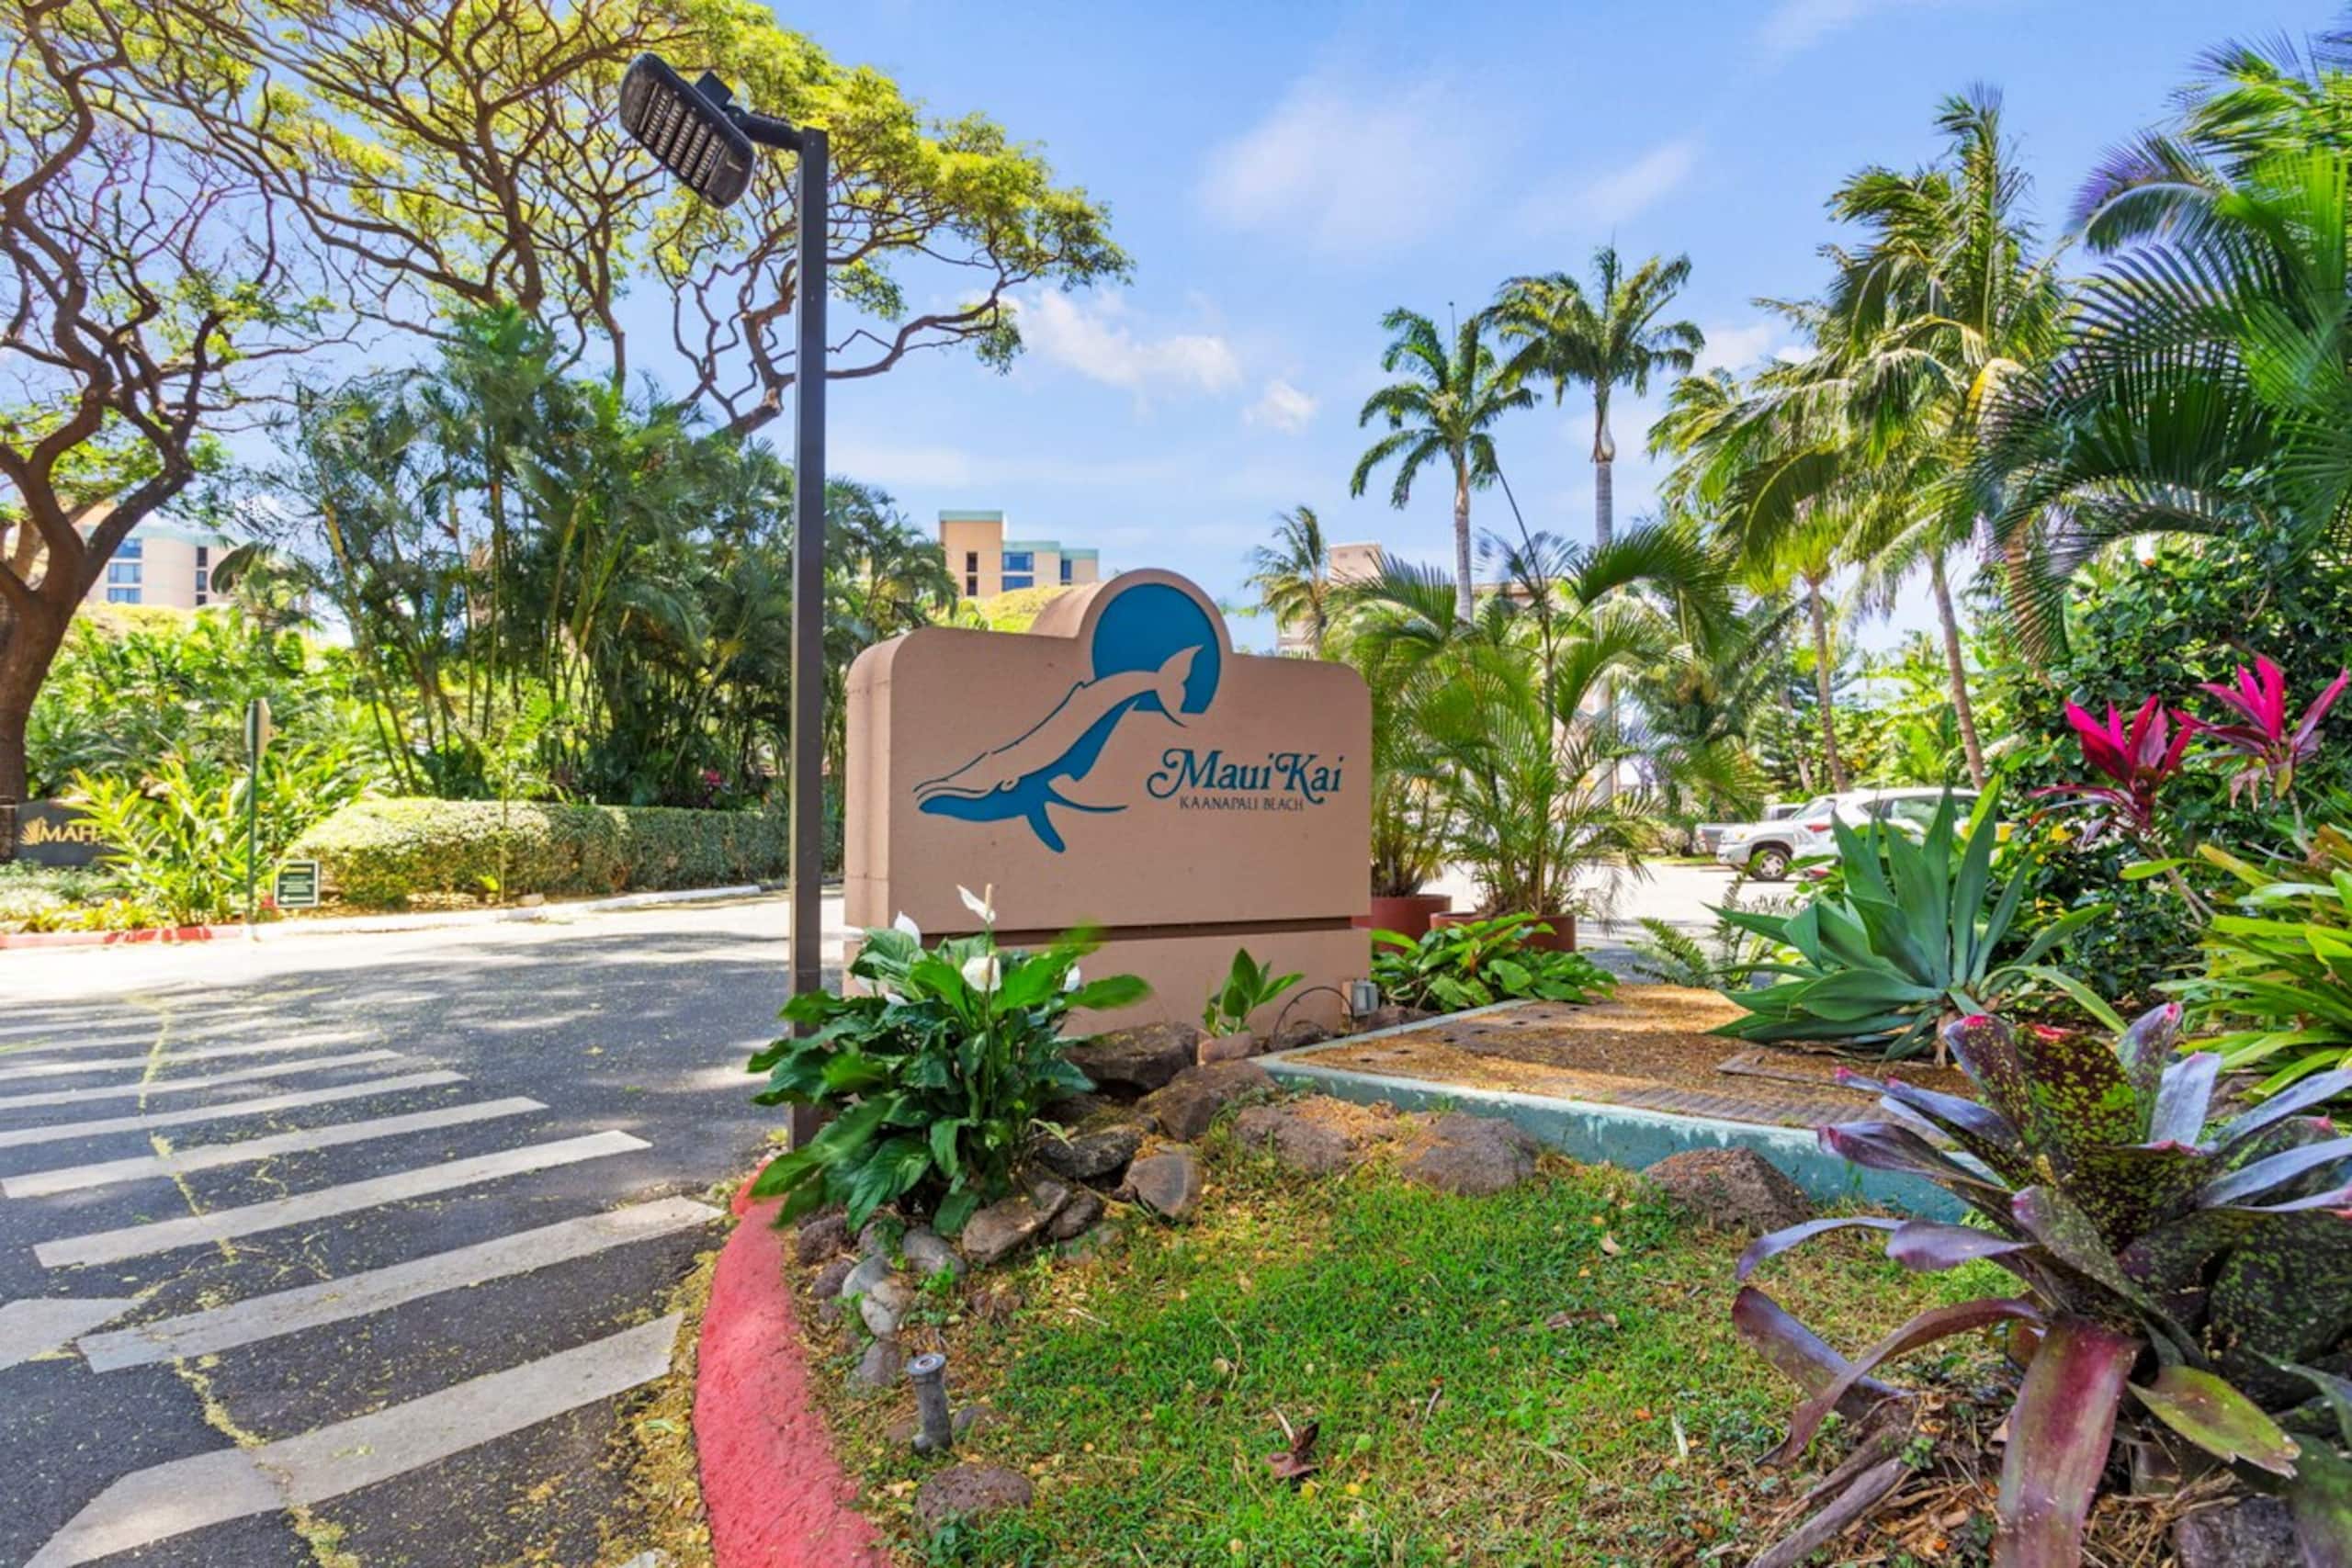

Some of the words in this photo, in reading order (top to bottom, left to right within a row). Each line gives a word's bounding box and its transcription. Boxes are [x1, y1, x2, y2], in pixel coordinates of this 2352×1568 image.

[1147, 748, 1275, 799] Maui
[1274, 752, 1345, 805] Kai
[1180, 795, 1259, 810] KAANAPALI
[1263, 797, 1304, 812] BEACH
[40, 825, 102, 841] MAH
